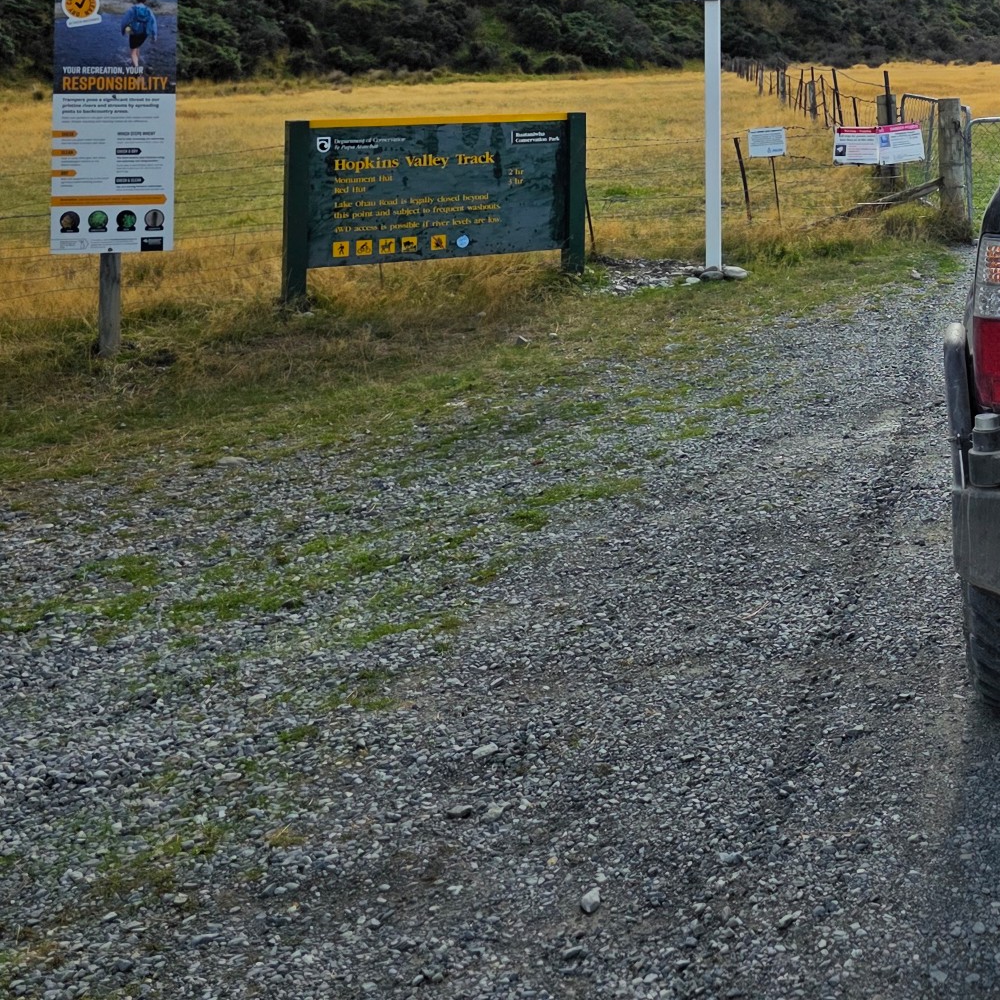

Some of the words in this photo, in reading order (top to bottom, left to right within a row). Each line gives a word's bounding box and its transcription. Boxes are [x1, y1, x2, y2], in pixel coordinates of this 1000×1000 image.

[63, 66, 81, 74] YOUR
[125, 66, 144, 74] YOUR
[62, 76, 168, 91] RESPONSIBILITY
[334, 156, 399, 174] Hopkins
[405, 153, 449, 169] Valley
[455, 151, 495, 166] Track
[335, 176, 376, 184] Monument
[379, 174, 393, 182] Hut
[334, 186, 349, 194] Red
[379, 198, 398, 206] Road
[410, 196, 434, 205] legally
[437, 195, 460, 203] closed
[463, 193, 489, 202] beyond
[334, 211, 350, 219] this
[352, 211, 373, 219] point
[375, 208, 391, 217] and
[393, 208, 420, 216] subject
[433, 205, 464, 213] frequent
[390, 221, 420, 231] possible
